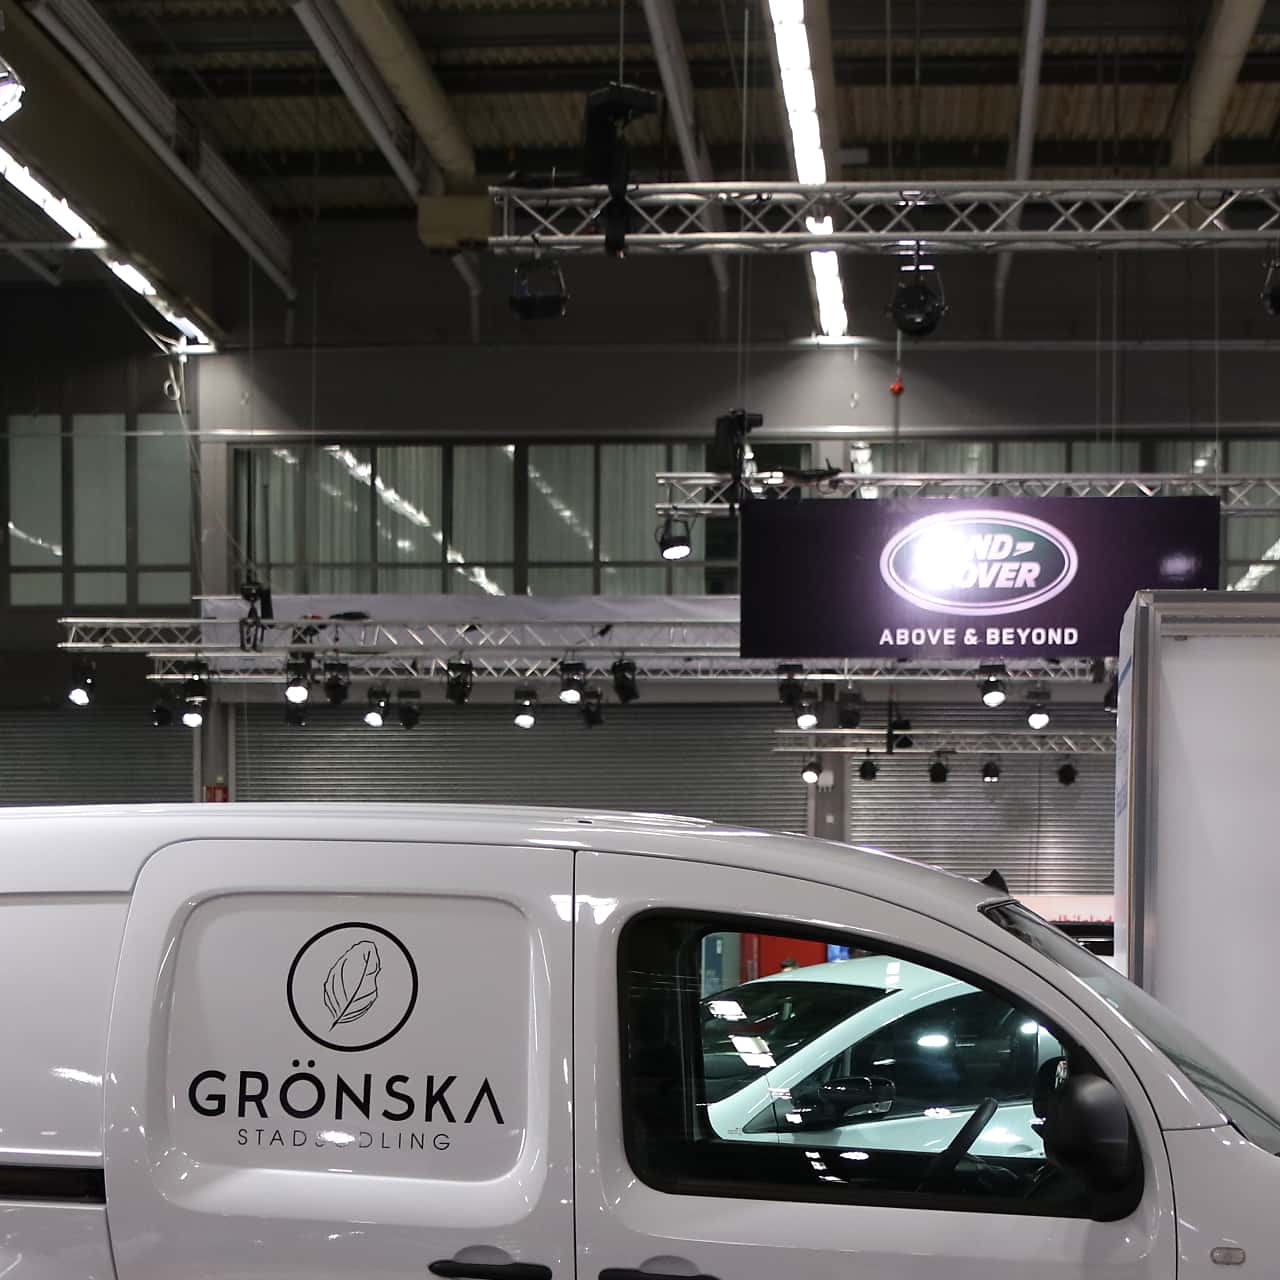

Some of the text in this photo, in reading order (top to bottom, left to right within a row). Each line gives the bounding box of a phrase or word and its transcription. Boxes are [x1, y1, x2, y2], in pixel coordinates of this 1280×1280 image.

[933, 562, 1041, 588] OVER
[879, 627, 1079, 646] ABOVE & BEYOND
[188, 1059, 505, 1125] GRÖNSKA
[237, 1128, 451, 1151] STADDLING
